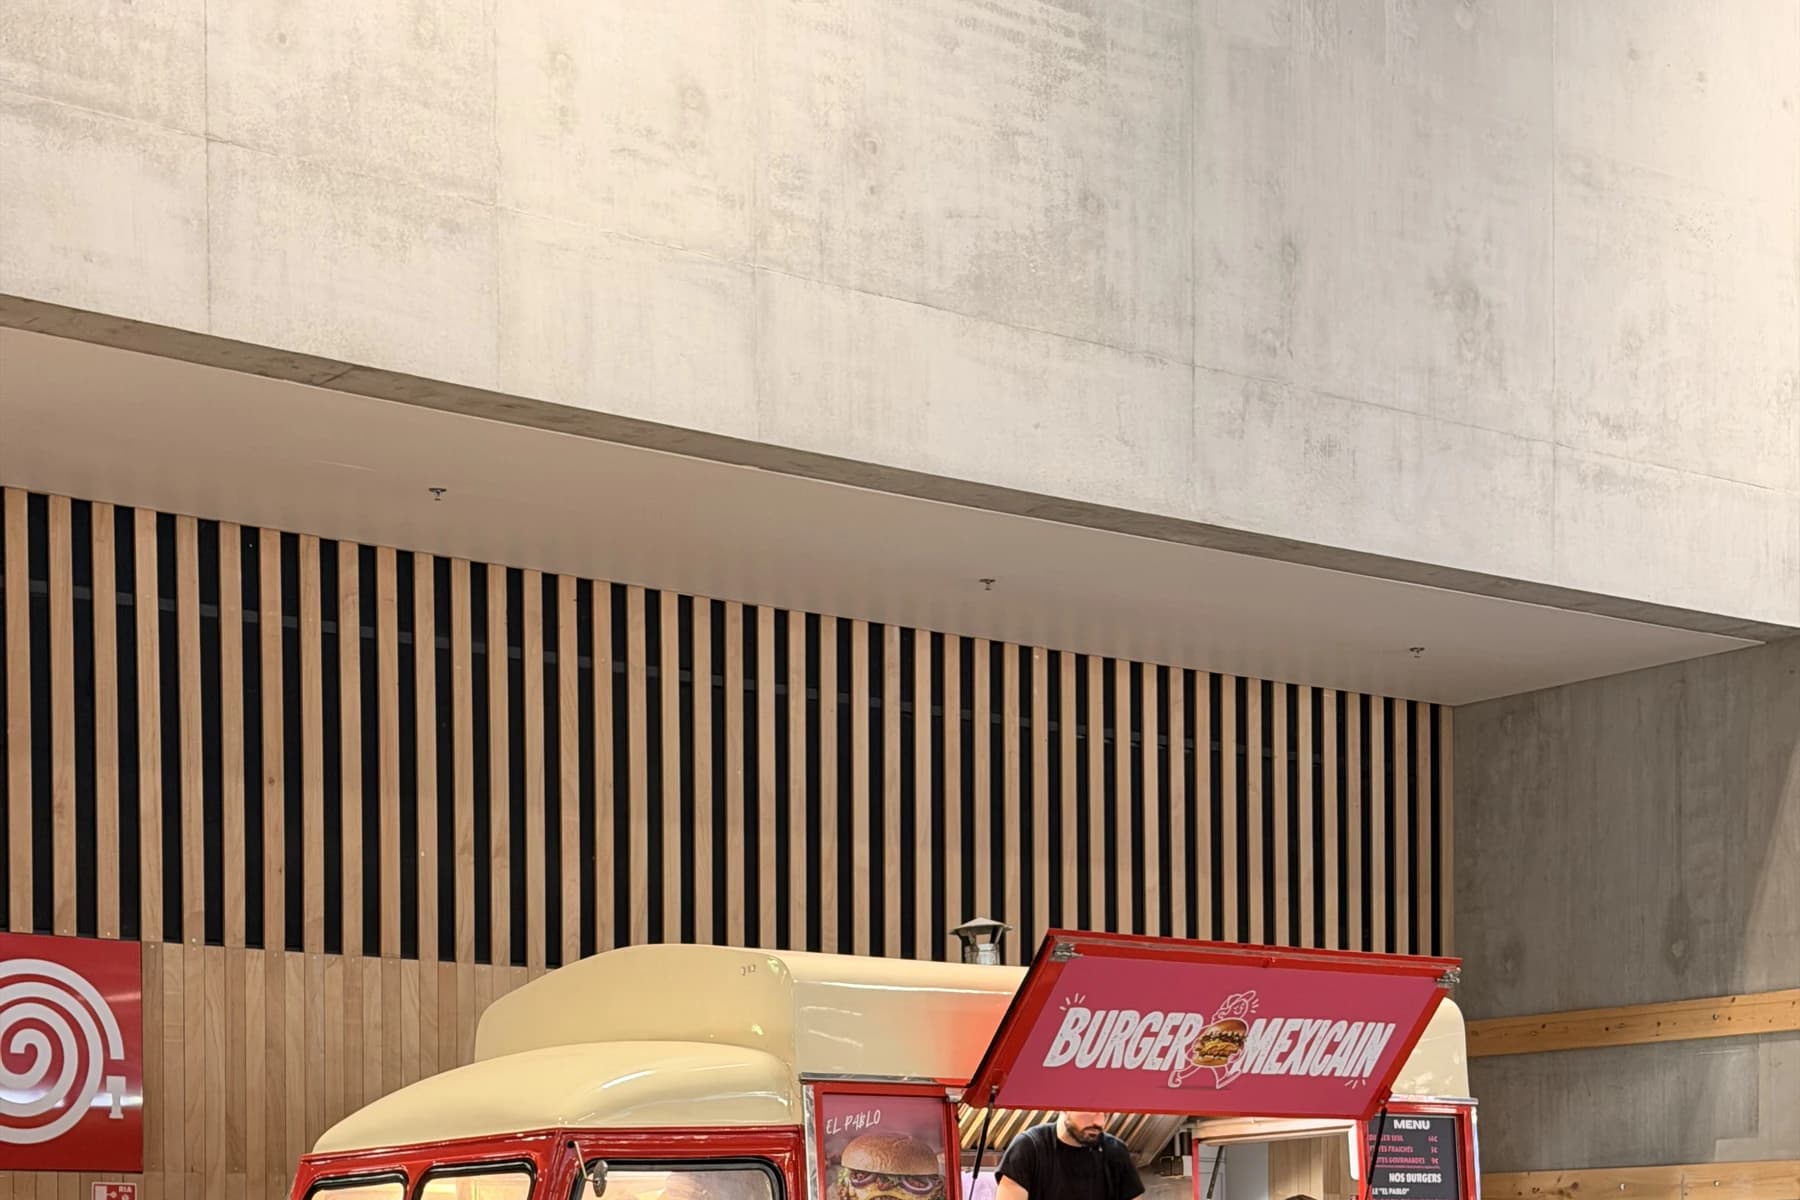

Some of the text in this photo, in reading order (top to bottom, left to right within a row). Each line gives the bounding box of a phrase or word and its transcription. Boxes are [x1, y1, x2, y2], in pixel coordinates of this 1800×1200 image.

[1043, 1007, 1396, 1078] BURGER MEXICAIN
[826, 1117, 841, 1135] EL
[1393, 1119, 1430, 1130] MENU
[1388, 1172, 1442, 1183] NOS BURGERS
